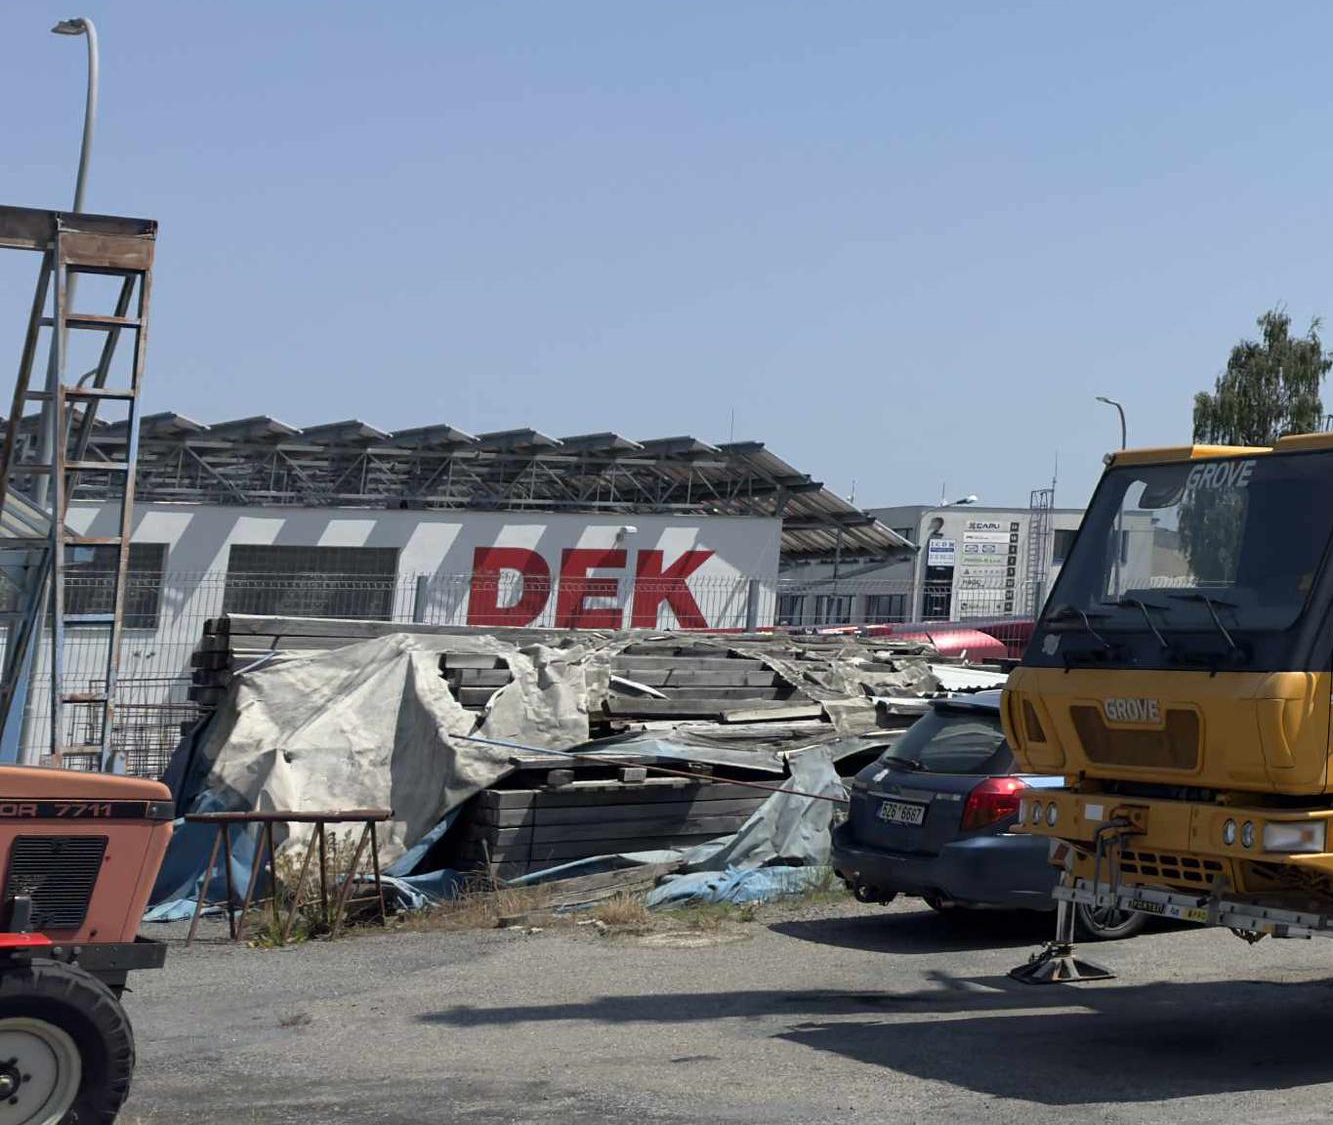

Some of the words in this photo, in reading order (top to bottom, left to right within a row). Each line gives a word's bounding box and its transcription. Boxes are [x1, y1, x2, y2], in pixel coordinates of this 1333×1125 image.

[1186, 459, 1257, 490] GROVE
[928, 517, 944, 537] 2
[467, 547, 715, 628] DEK
[1104, 697, 1159, 721] GROVE
[53, 803, 112, 817] 7711
